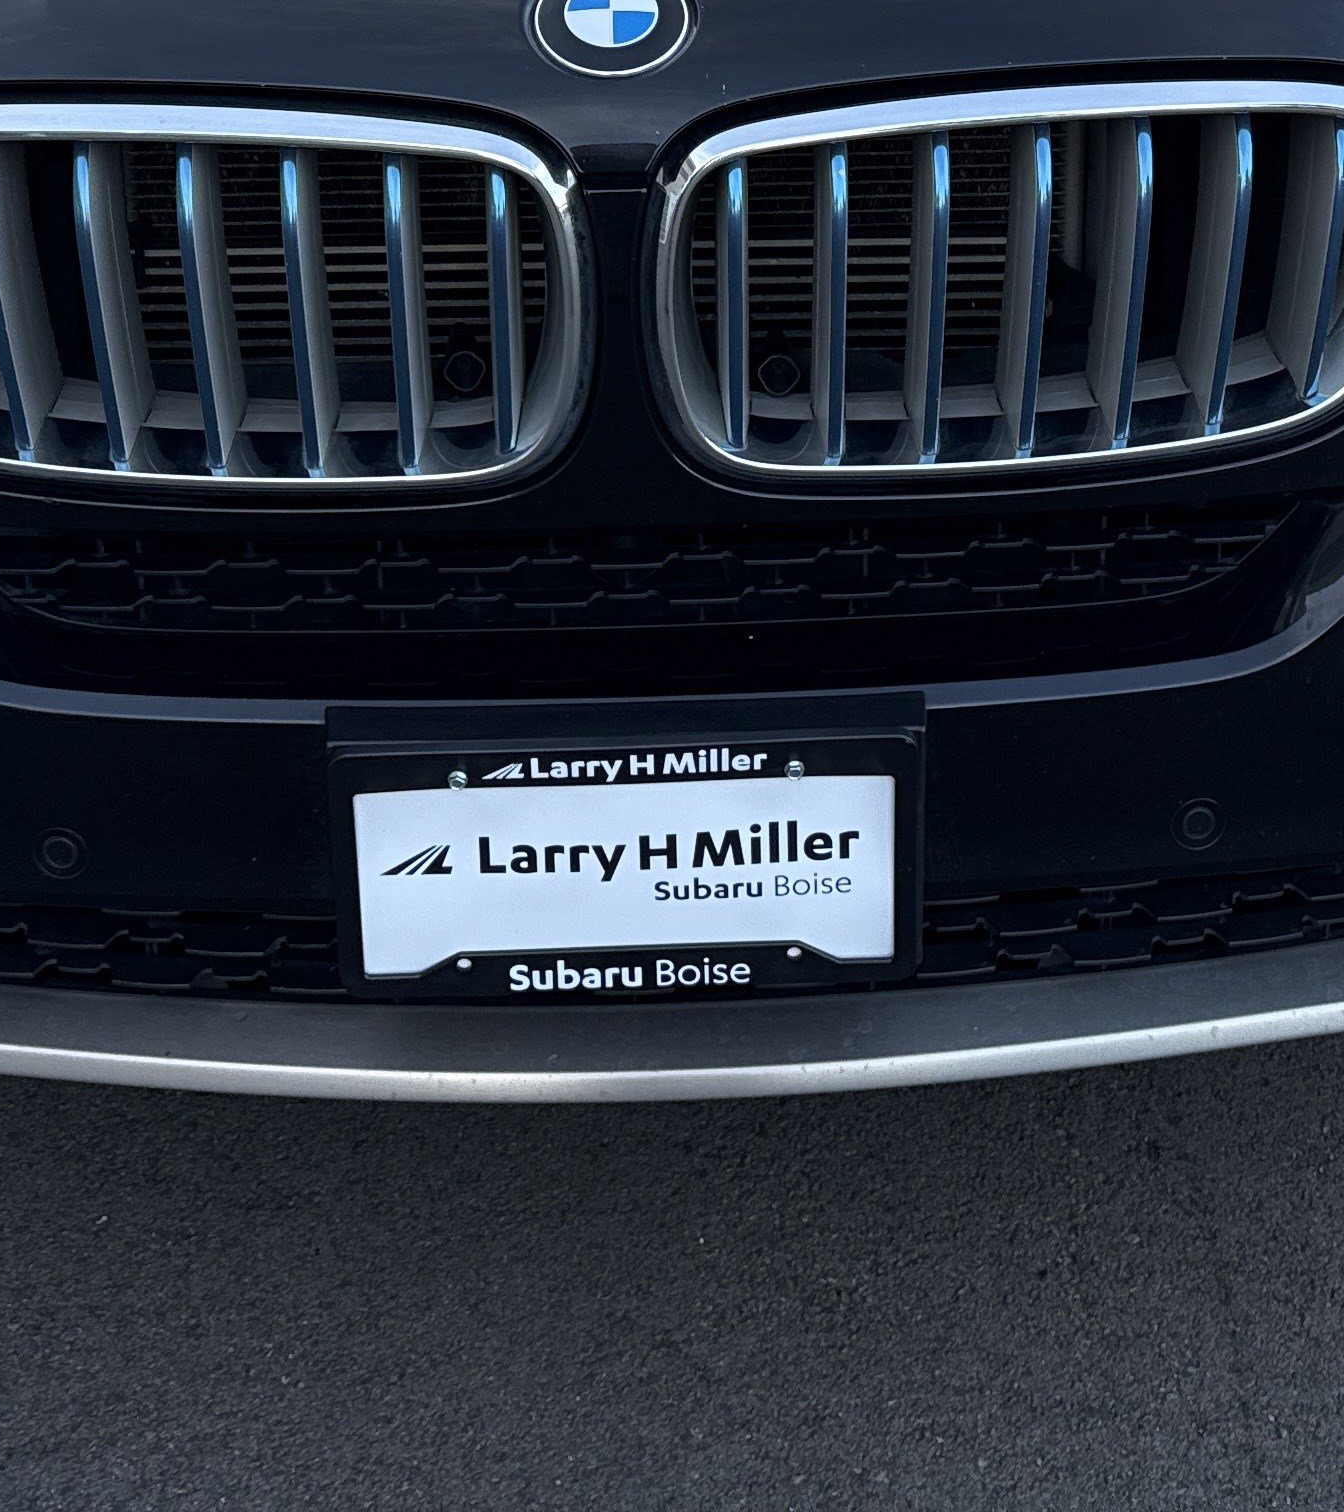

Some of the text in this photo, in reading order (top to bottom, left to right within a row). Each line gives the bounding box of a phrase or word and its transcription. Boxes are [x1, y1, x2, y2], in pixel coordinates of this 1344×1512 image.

[530, 748, 768, 782] Larry H Miller
[478, 819, 860, 883] Larry H Miller
[654, 873, 852, 901] Subaru Boise
[509, 957, 751, 992] Subaru Boise
